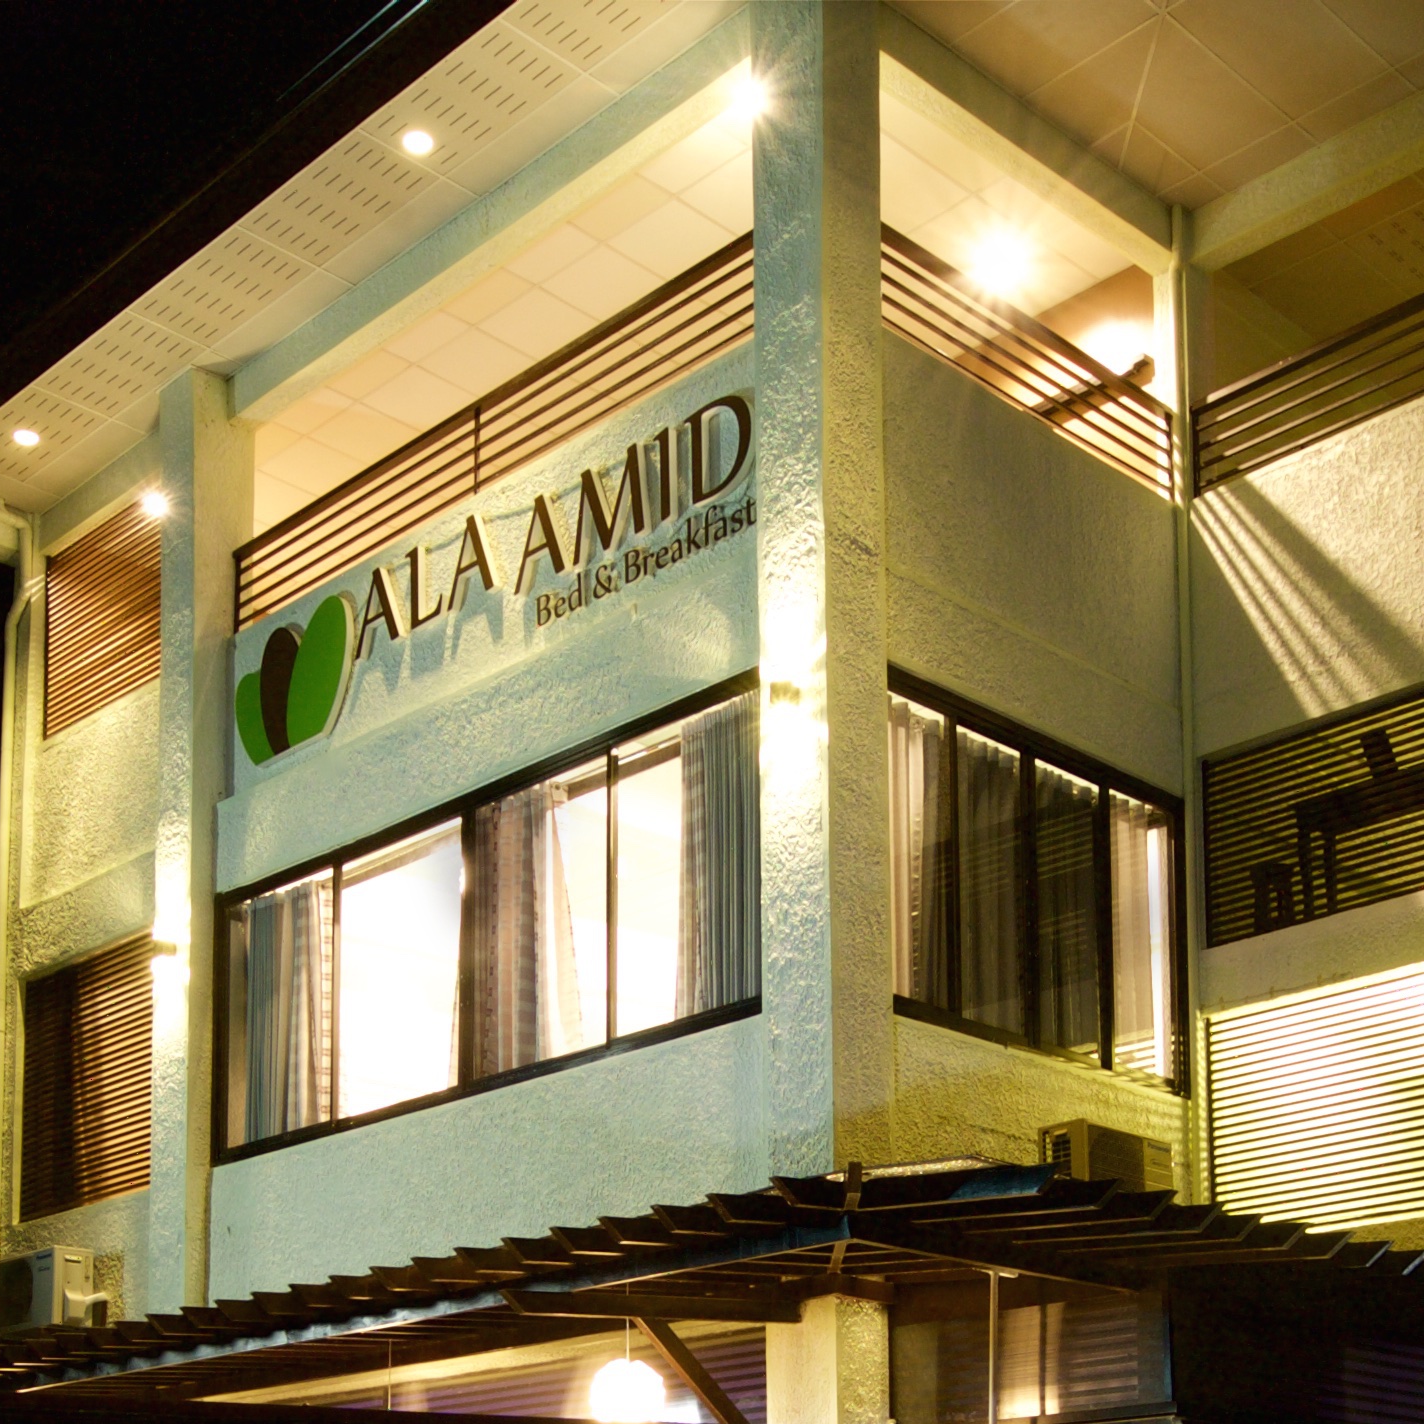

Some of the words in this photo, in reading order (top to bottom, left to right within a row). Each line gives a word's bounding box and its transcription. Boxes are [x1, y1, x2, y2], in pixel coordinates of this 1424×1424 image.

[535, 580, 585, 627] Bed
[593, 567, 618, 599] &
[624, 498, 757, 581] Breakfast
